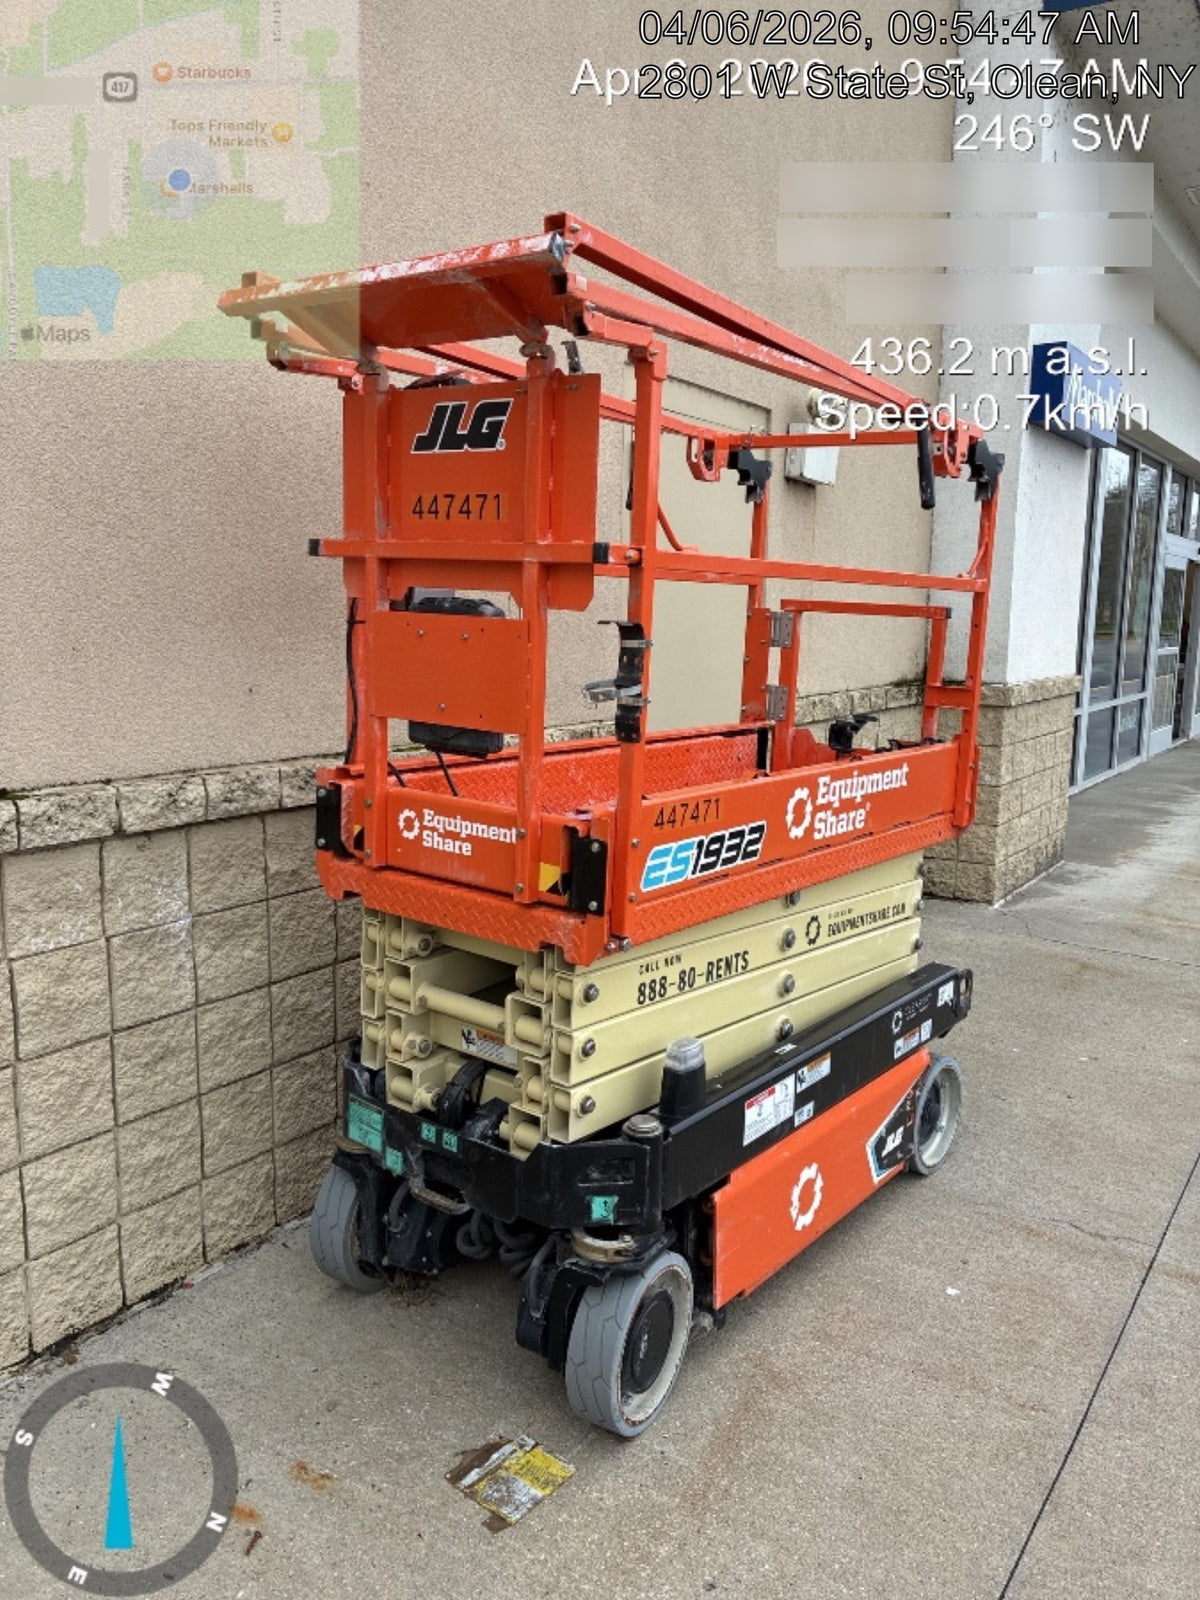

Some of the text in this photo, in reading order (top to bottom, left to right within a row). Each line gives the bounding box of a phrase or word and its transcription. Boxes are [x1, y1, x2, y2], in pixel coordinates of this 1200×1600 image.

[410, 397, 514, 454] JLG
[411, 494, 501, 520] 447471
[815, 763, 909, 806] Equipment
[422, 808, 517, 844] Equipment
[653, 797, 721, 831] 447471
[813, 807, 866, 840] Share
[422, 831, 472, 857] Share
[641, 821, 767, 892] ES1932
[637, 950, 749, 1006] 888-80-RENTS
[639, 960, 660, 975] CALL
